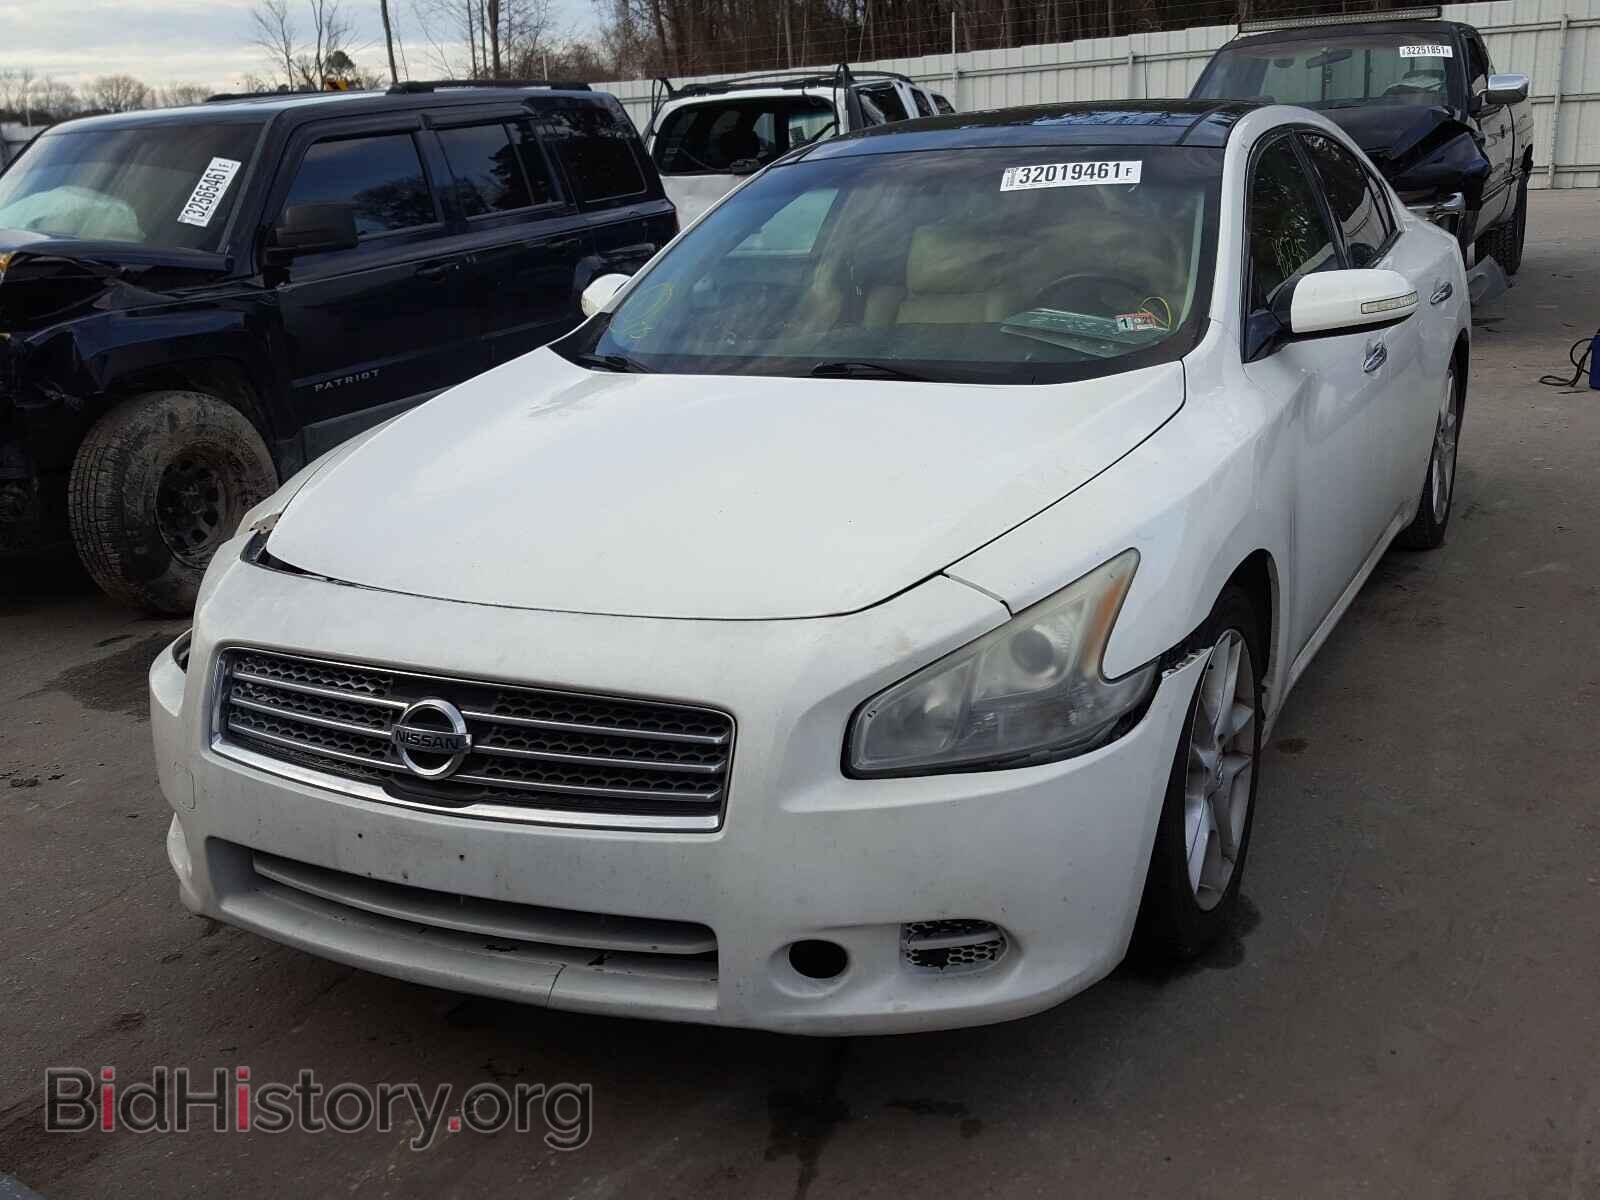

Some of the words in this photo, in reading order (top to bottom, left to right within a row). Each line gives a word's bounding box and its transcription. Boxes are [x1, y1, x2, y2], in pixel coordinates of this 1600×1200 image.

[1018, 162, 1122, 184] 32019461
[1125, 167, 1134, 177] F
[185, 168, 230, 217] 32565461
[313, 368, 380, 392] PATRIOT
[395, 730, 461, 752] NISSAN
